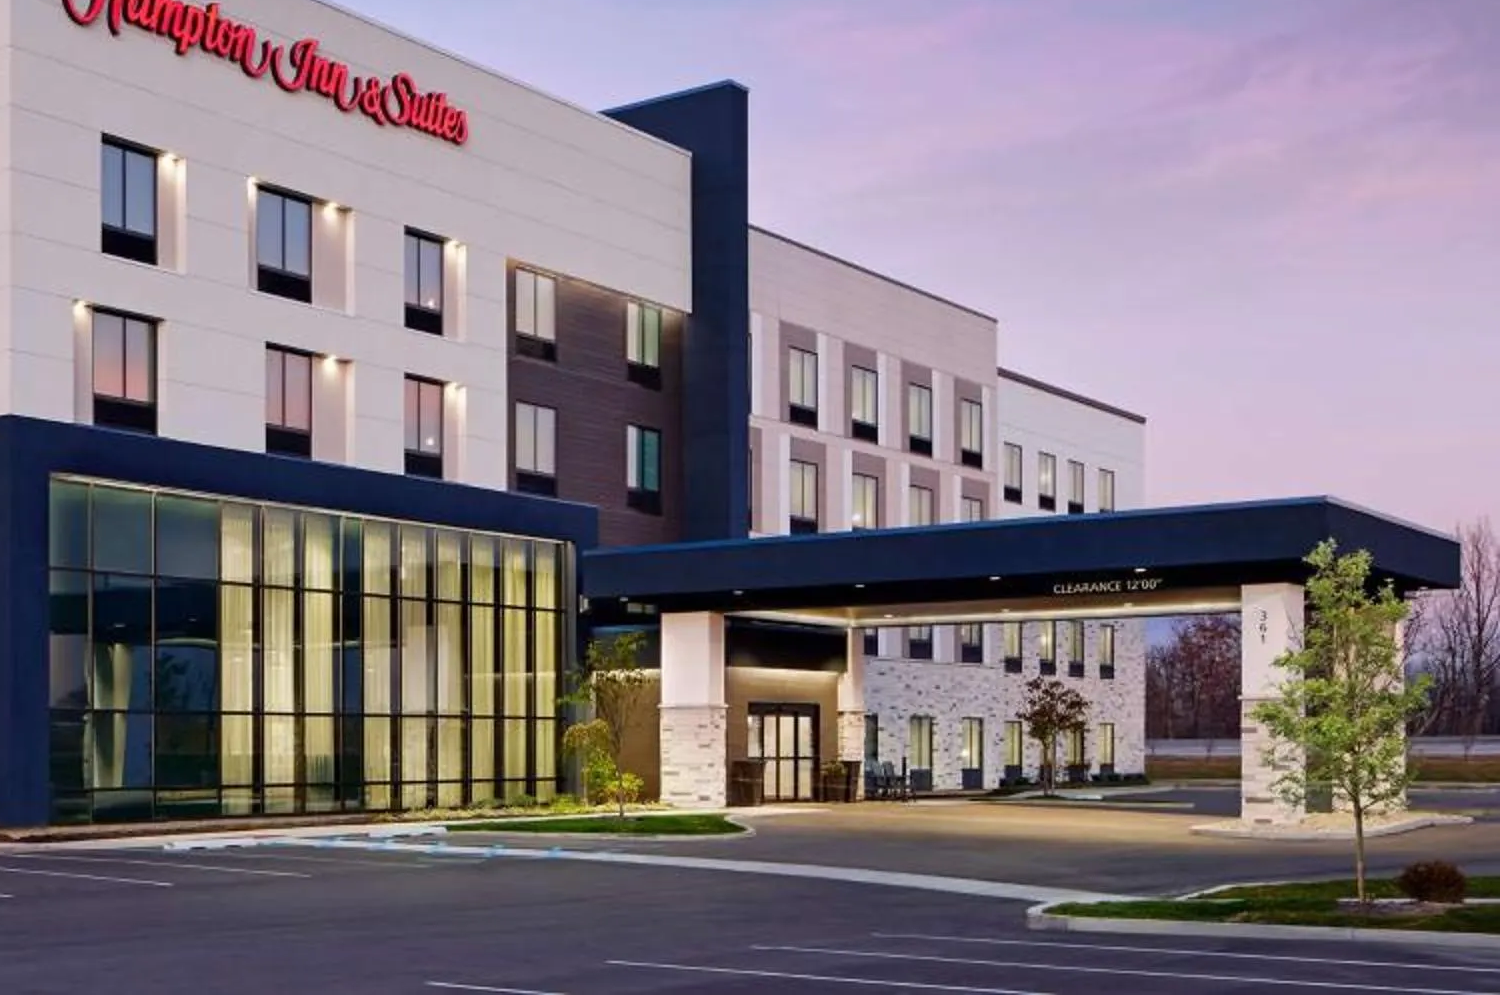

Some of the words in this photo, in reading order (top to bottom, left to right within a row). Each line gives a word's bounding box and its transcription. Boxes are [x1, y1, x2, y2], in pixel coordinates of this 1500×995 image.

[269, 37, 365, 112] Inn
[381, 72, 468, 146] Suites
[1053, 580, 1121, 594] CLEARANCE
